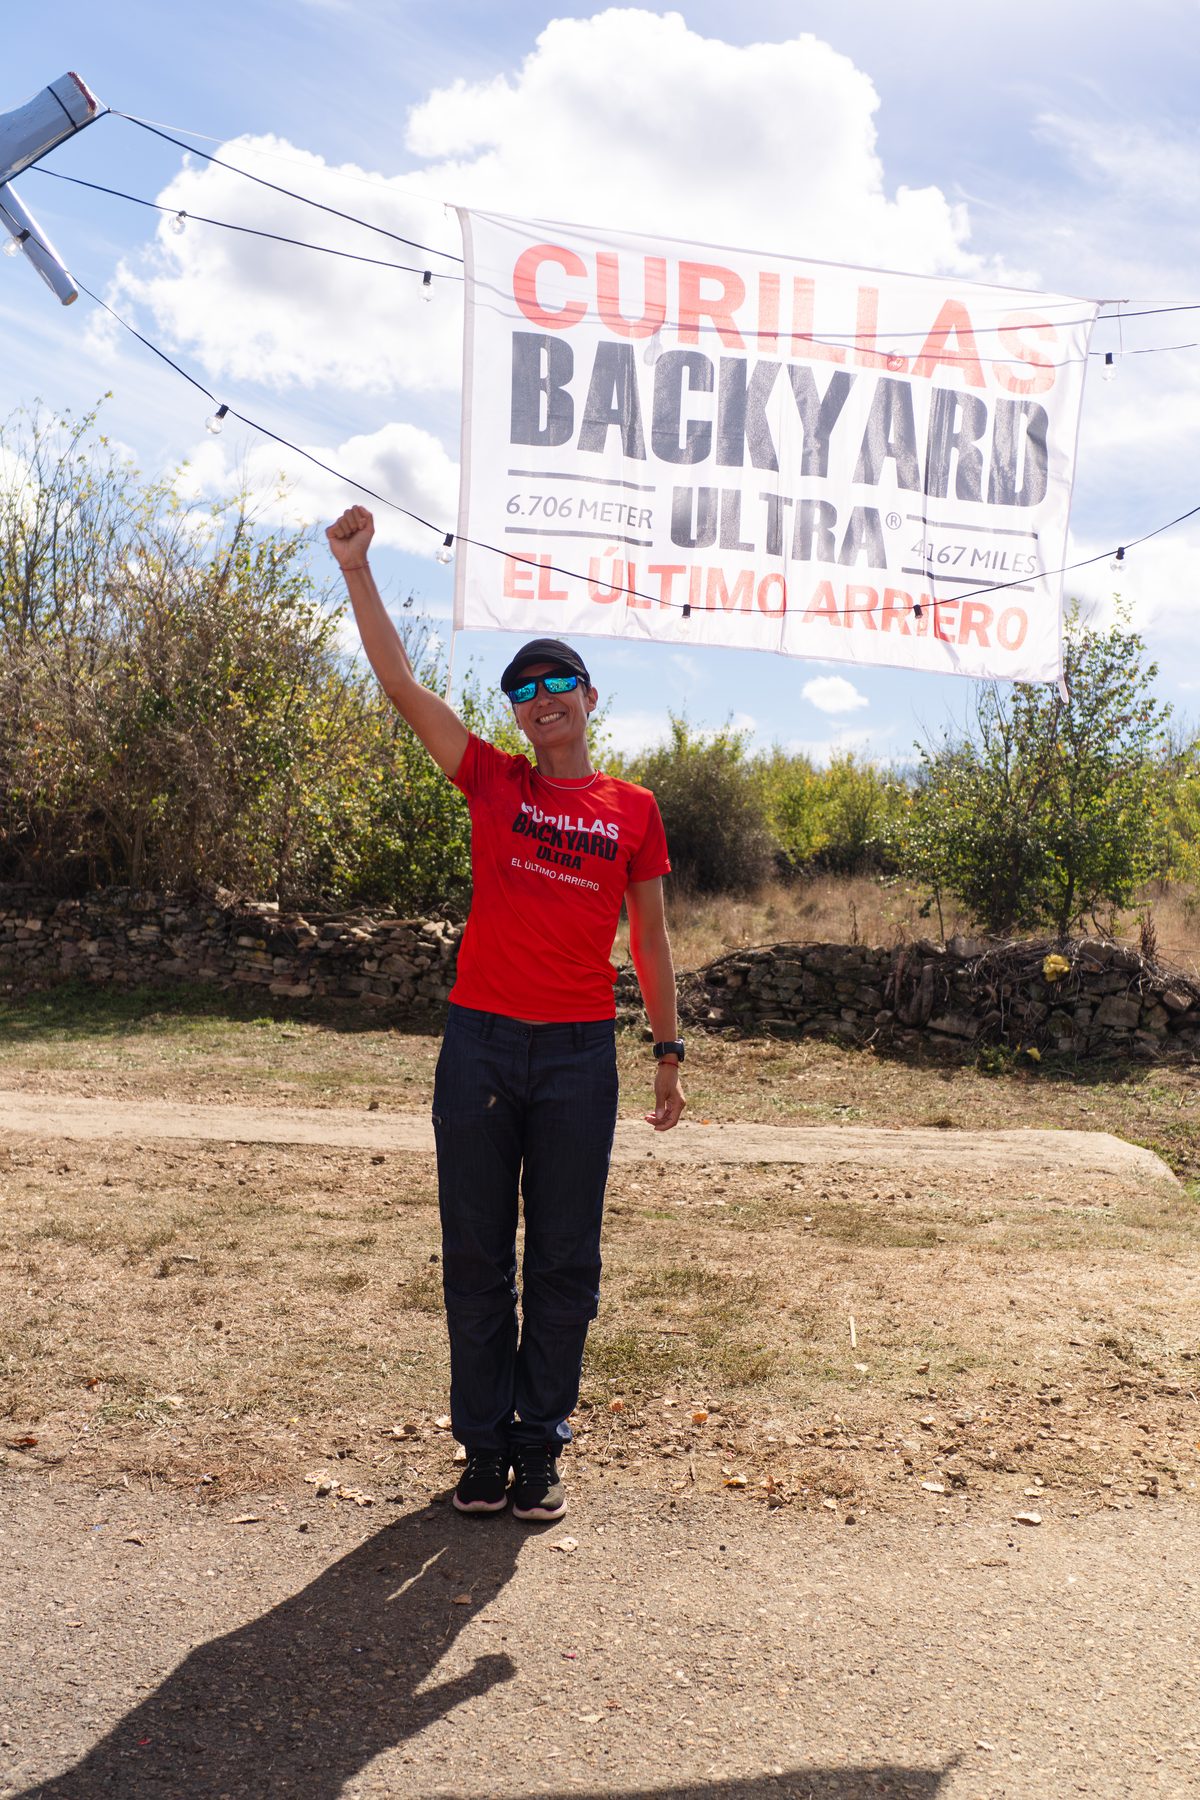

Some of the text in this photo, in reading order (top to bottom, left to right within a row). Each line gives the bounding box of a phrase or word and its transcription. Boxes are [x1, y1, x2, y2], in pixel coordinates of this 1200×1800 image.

[512, 244, 1059, 395] CURILLAS
[510, 331, 1049, 507] BACKYARD
[506, 494, 654, 530] 6.706 METER
[970, 548, 1038, 575] MILES
[503, 546, 1029, 651] EL ÚLTIMO ARRIERO
[511, 812, 619, 862] BACKYARD
[511, 857, 522, 868] EL
[557, 873, 600, 892] ARRIERO
